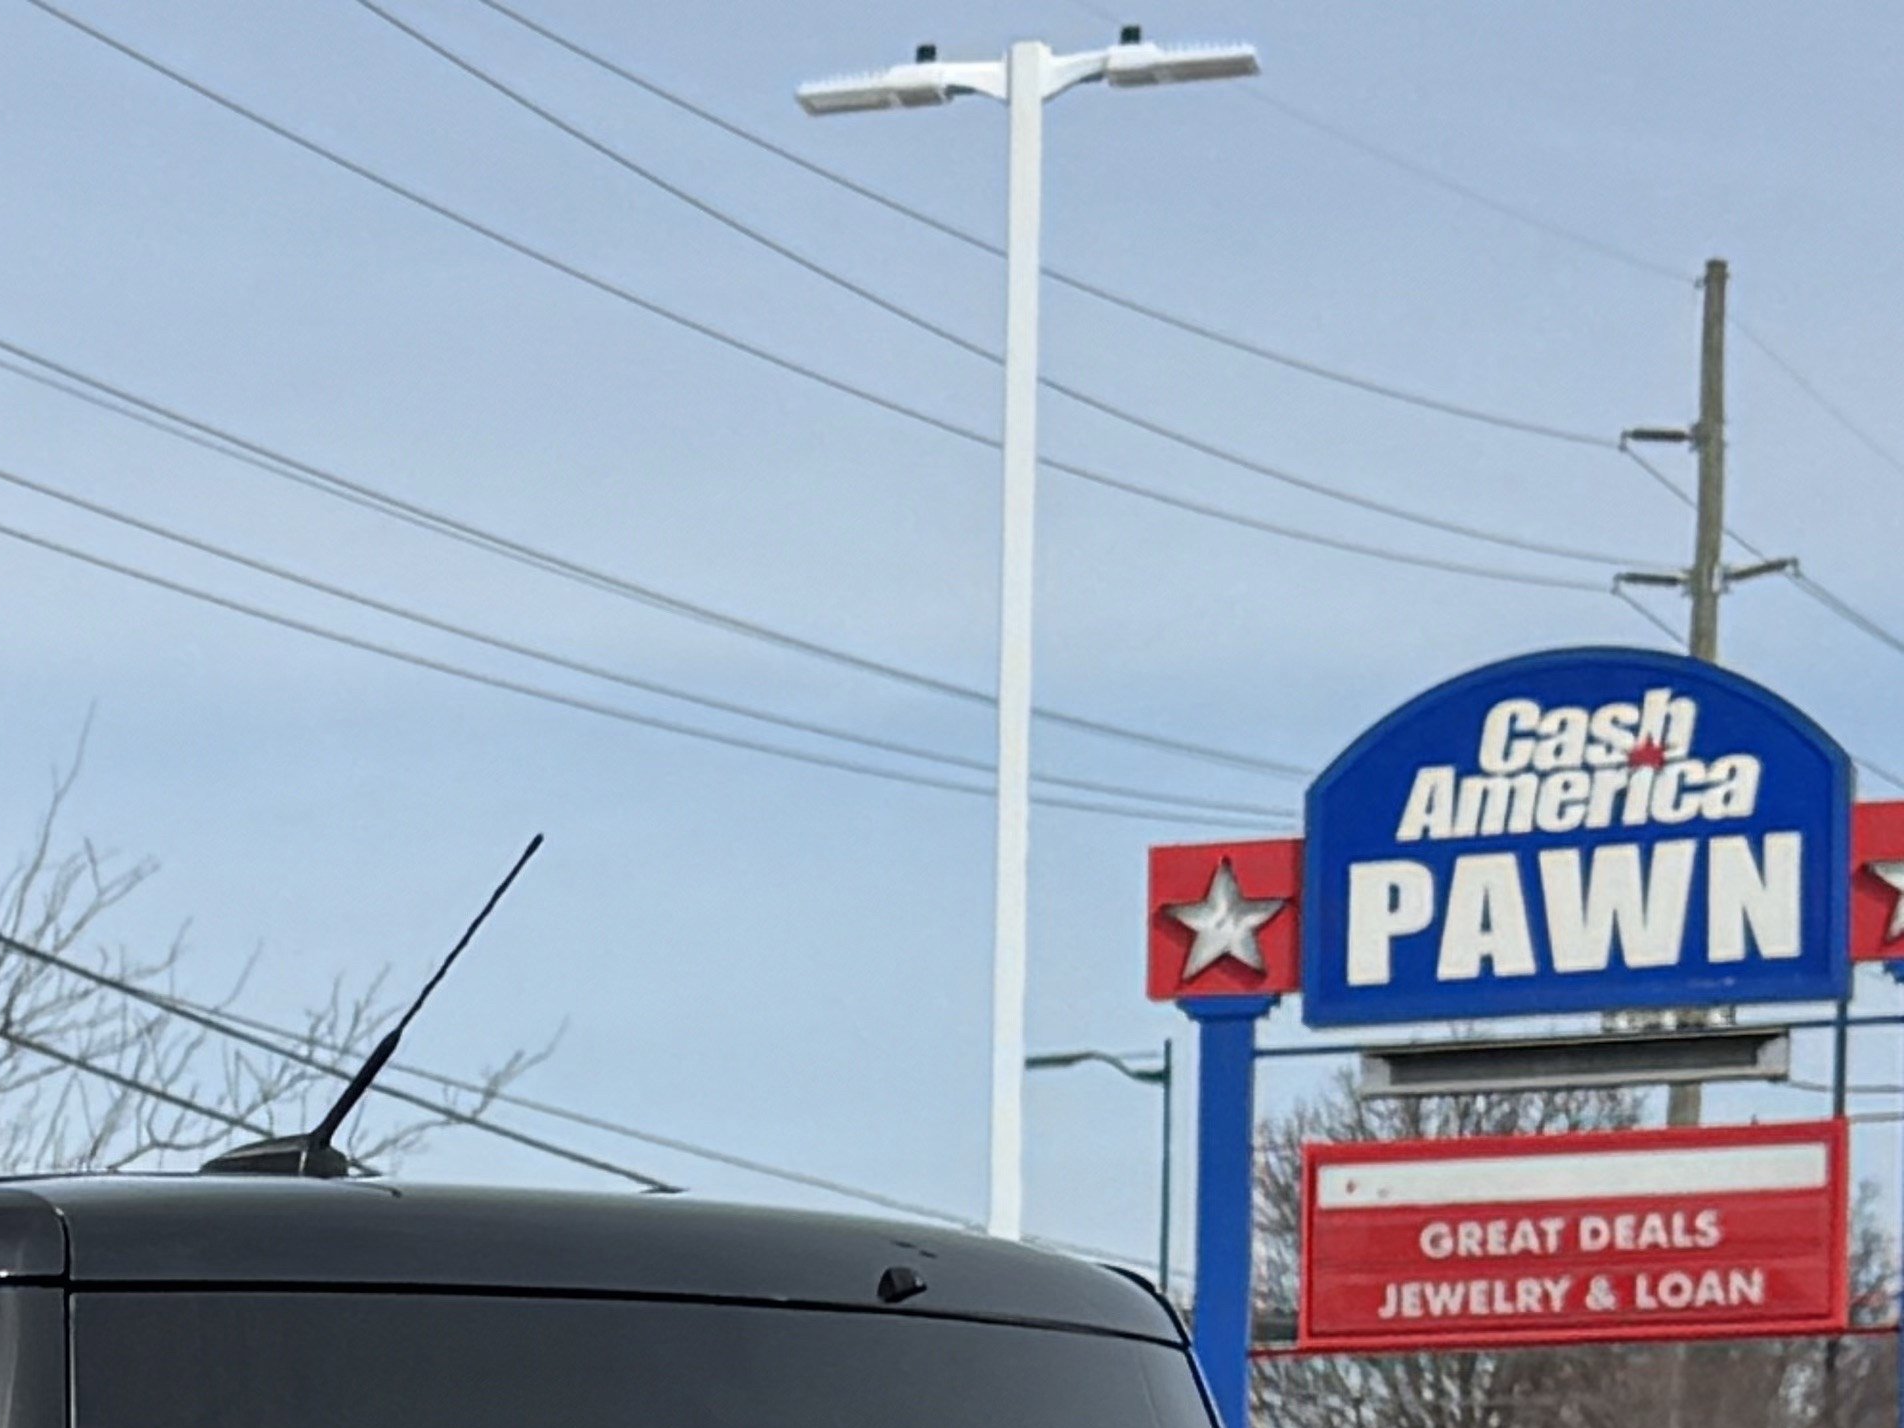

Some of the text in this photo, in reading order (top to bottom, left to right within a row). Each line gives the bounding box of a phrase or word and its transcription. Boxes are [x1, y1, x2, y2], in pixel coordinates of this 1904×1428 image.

[1480, 687, 1697, 775] Cash
[1395, 754, 1761, 842] America
[1347, 831, 1802, 985] PAWN
[1419, 1209, 1724, 1260] GREAT DEALS
[1378, 1267, 1765, 1320] JEWELRY & LOAN
